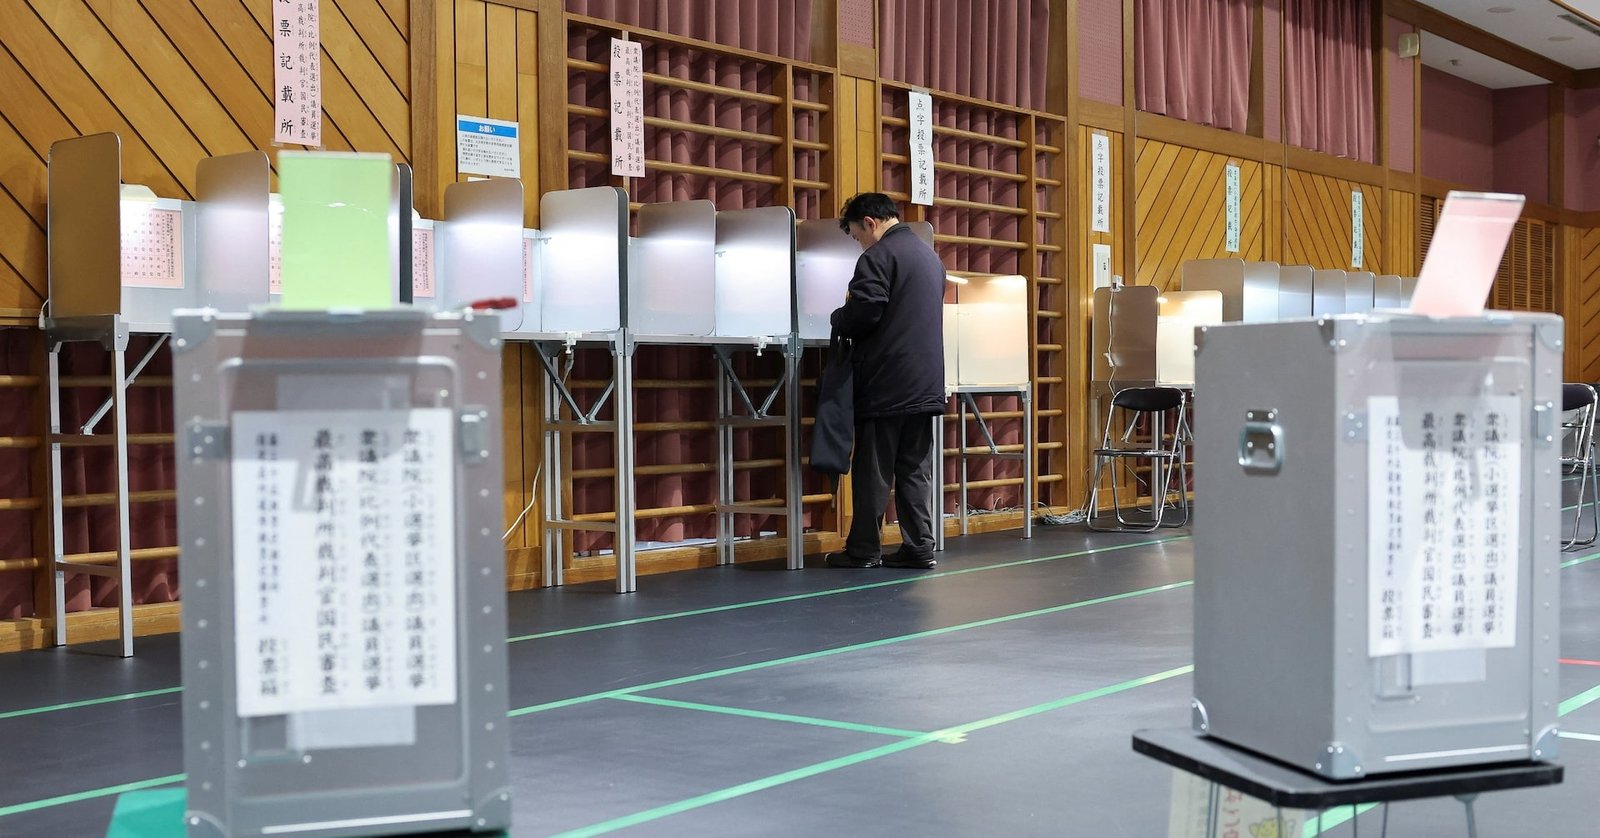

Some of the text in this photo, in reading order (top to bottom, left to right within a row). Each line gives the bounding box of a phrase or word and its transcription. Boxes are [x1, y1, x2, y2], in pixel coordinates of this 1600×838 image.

[279, 0, 293, 136] 票記載所
[613, 44, 623, 169] 投票記載所
[916, 99, 928, 200] 点字投票記載所
